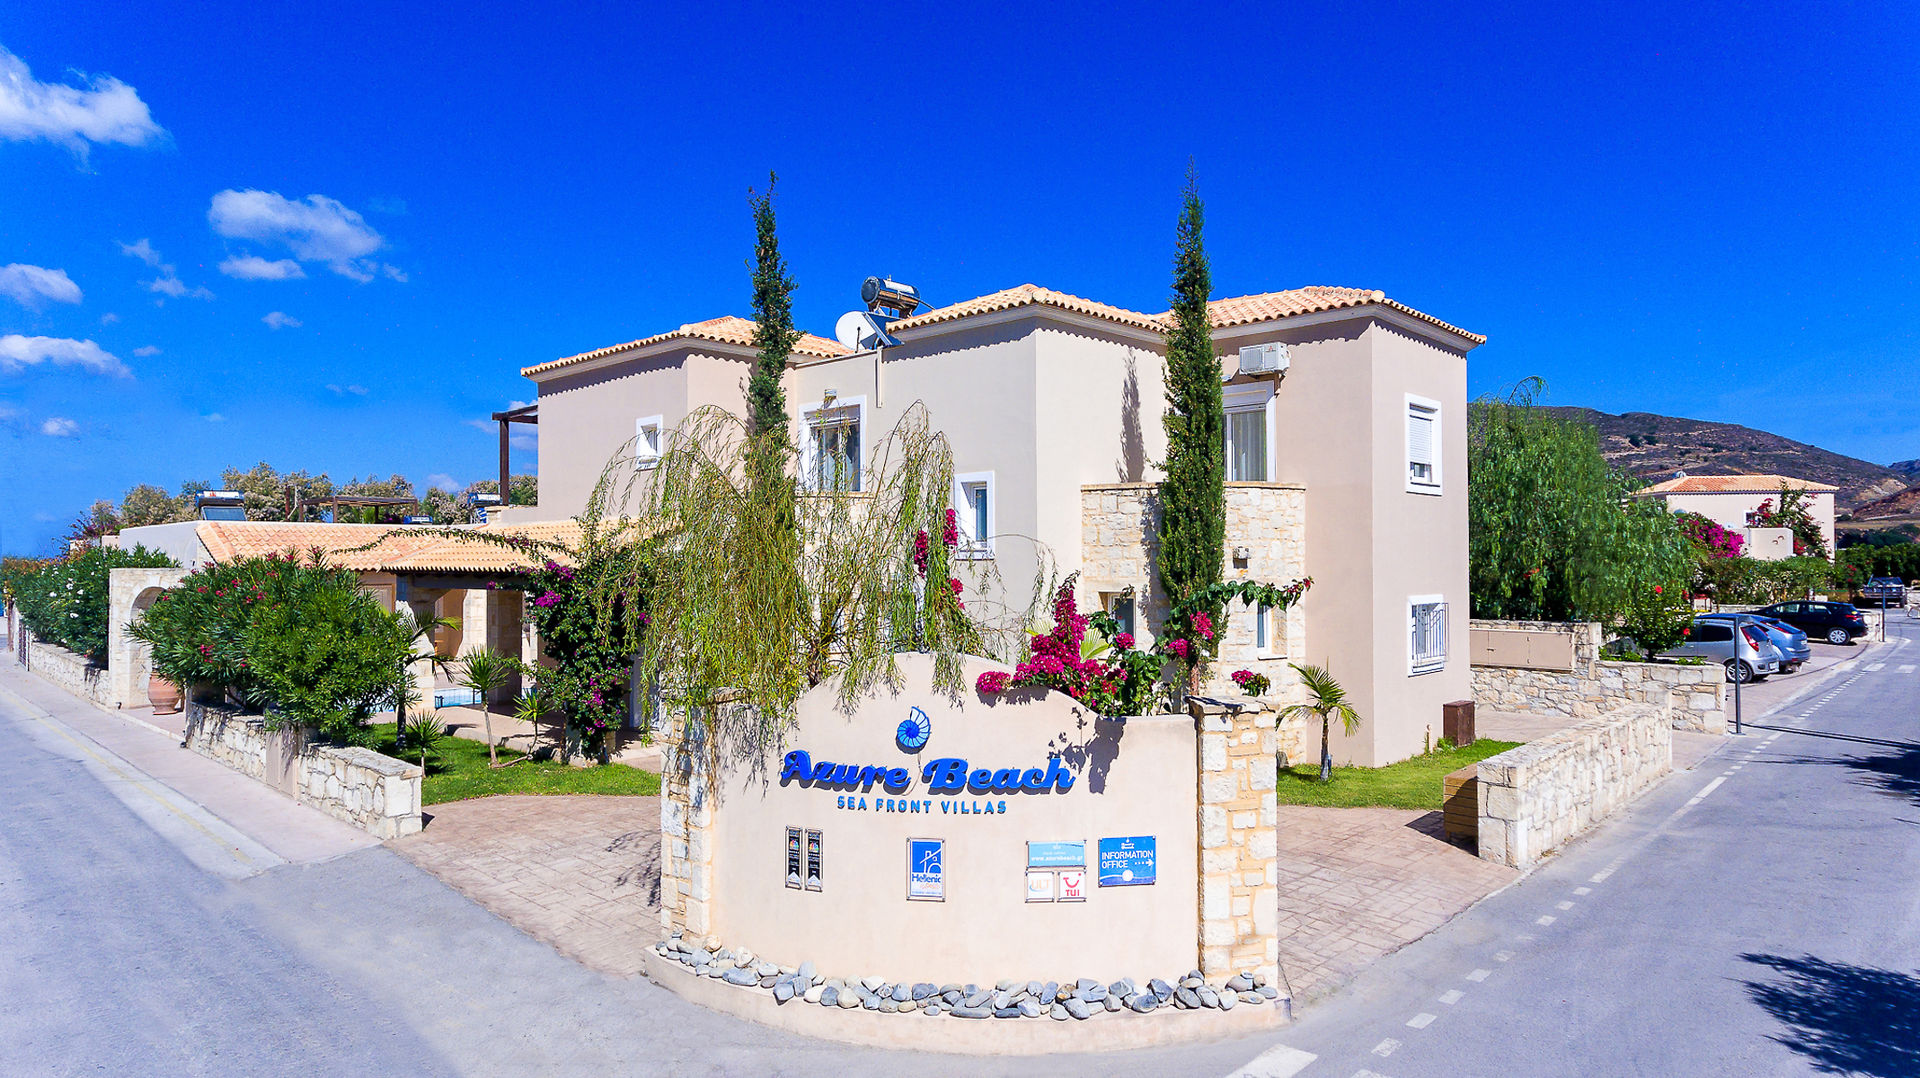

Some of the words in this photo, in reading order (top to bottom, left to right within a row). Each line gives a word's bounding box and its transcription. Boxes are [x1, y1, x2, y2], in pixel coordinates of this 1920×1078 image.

[781, 750, 911, 788] Azure
[923, 758, 1076, 789] Beach
[837, 795, 867, 810] SEA
[876, 798, 932, 813] FRONT
[940, 800, 1007, 814] VILLAS
[1101, 850, 1154, 860] INFORMATION
[1101, 860, 1129, 869] OFFICE
[911, 873, 941, 883] Hellenic
